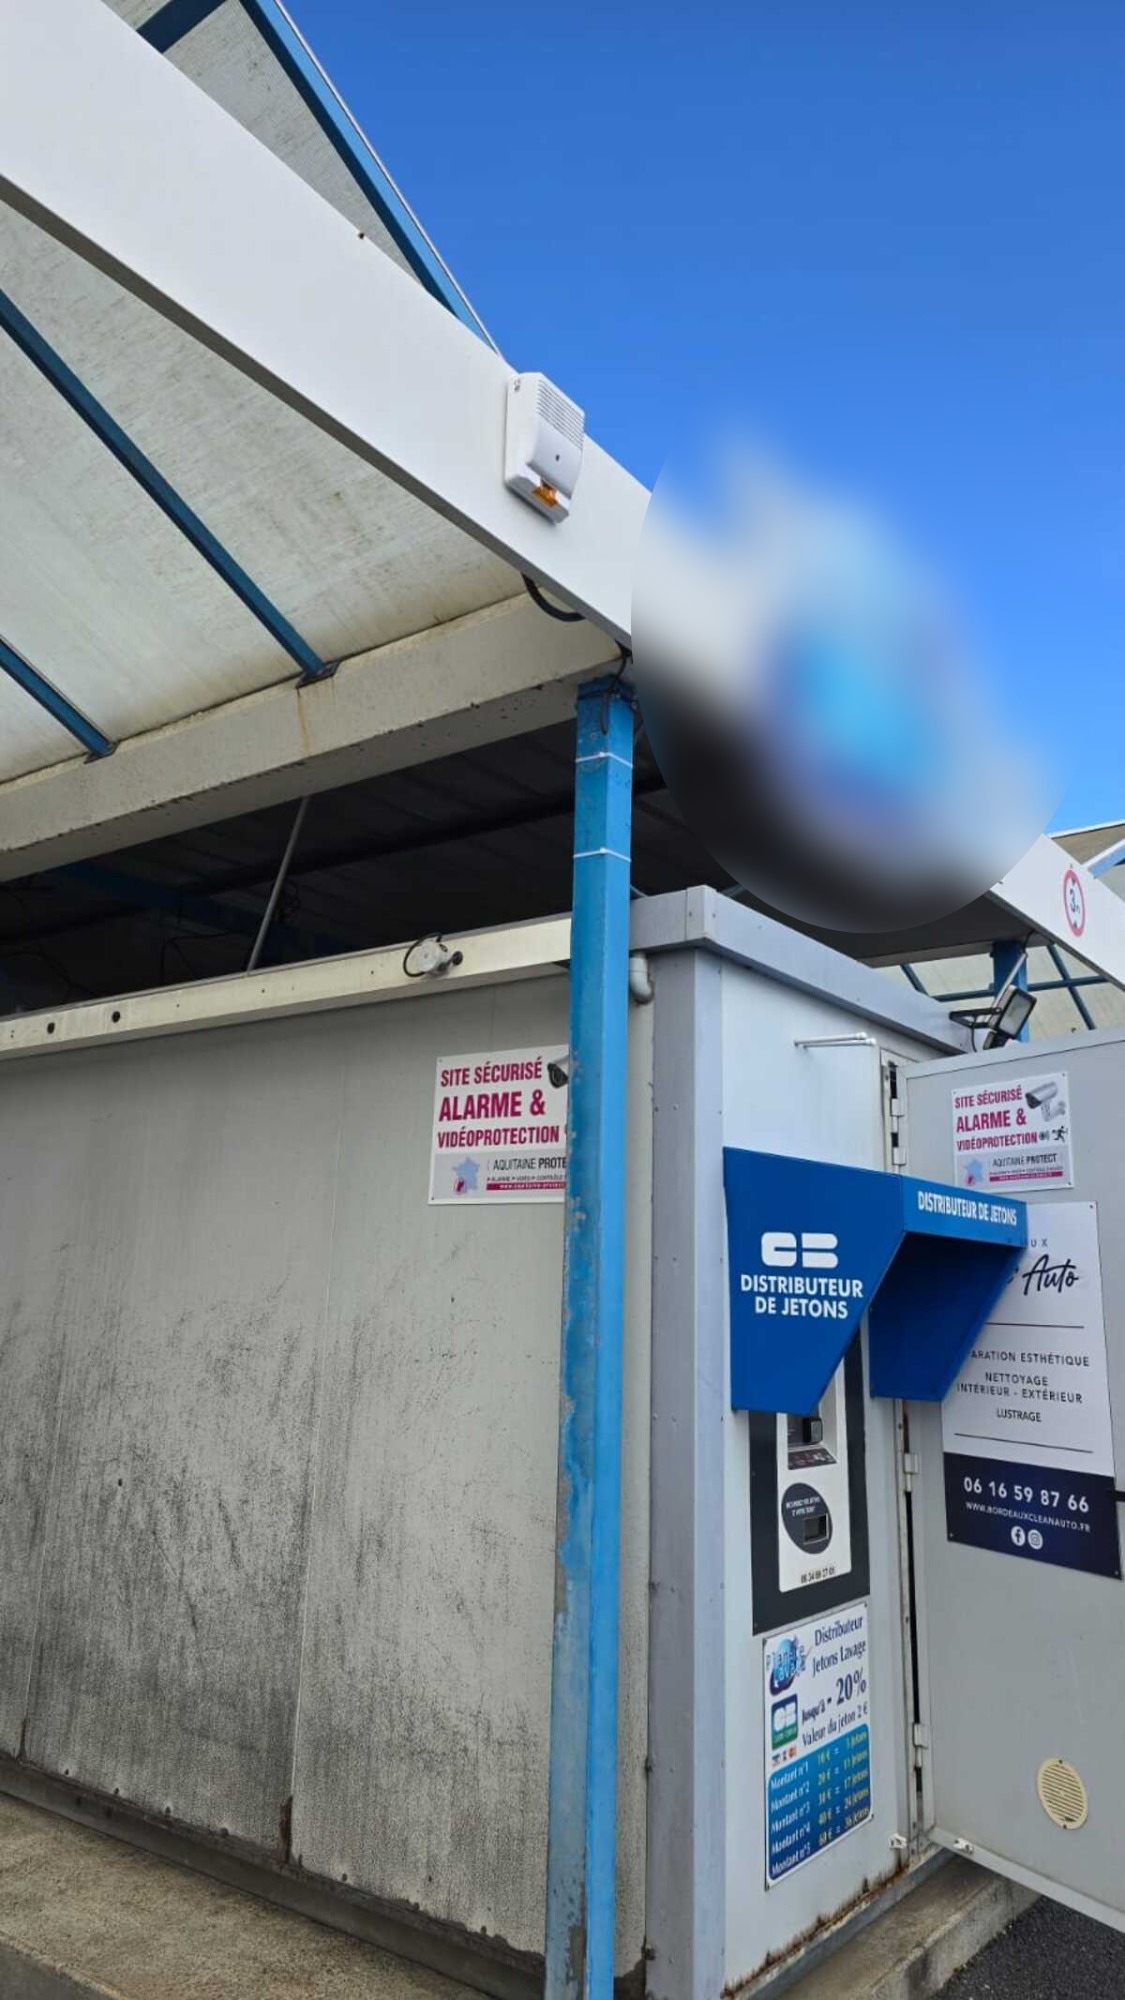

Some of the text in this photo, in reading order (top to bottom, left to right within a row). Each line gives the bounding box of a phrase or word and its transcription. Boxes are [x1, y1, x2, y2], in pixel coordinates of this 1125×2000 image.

[441, 1056, 542, 1087] SITE SÉCURISÉ
[439, 1089, 546, 1122] ALARME &
[955, 1084, 1022, 1109] SITE SÉCURISÉ
[957, 1108, 1027, 1133] ALARME &
[438, 1126, 559, 1148] VIDÉOPROTECTION
[957, 1131, 1038, 1152] VIDÉOPROTECTION
[493, 1158, 536, 1171] AQUITAINE
[918, 1191, 1017, 1226] DISTRIBUTEUR DE JETONS
[761, 1232, 838, 1269] CB
[740, 1274, 864, 1299] DISTRIBUTEUR
[1022, 1254, 1079, 1296] Auto
[754, 1297, 849, 1319] DE JETONS
[1020, 1352, 1090, 1367] ESTHÉTIQUE
[985, 1372, 1048, 1387] NETTOYAGE
[957, 1382, 1010, 1397] INTÉRIEUR
[1022, 1388, 1083, 1404] EXTÉRIEUR
[996, 1408, 1042, 1422] LUSTRAGE
[964, 1477, 1089, 1513] 06 16 59 87 66
[814, 1616, 863, 1647] Distributeur
[812, 1640, 867, 1678] Jetons Lavage
[836, 1666, 867, 1706] 20%
[802, 1724, 826, 1747] Valeur
[827, 1719, 837, 1734] du
[838, 1709, 856, 1733] jeton
[857, 1705, 862, 1719] 2
[863, 1701, 868, 1715] €
